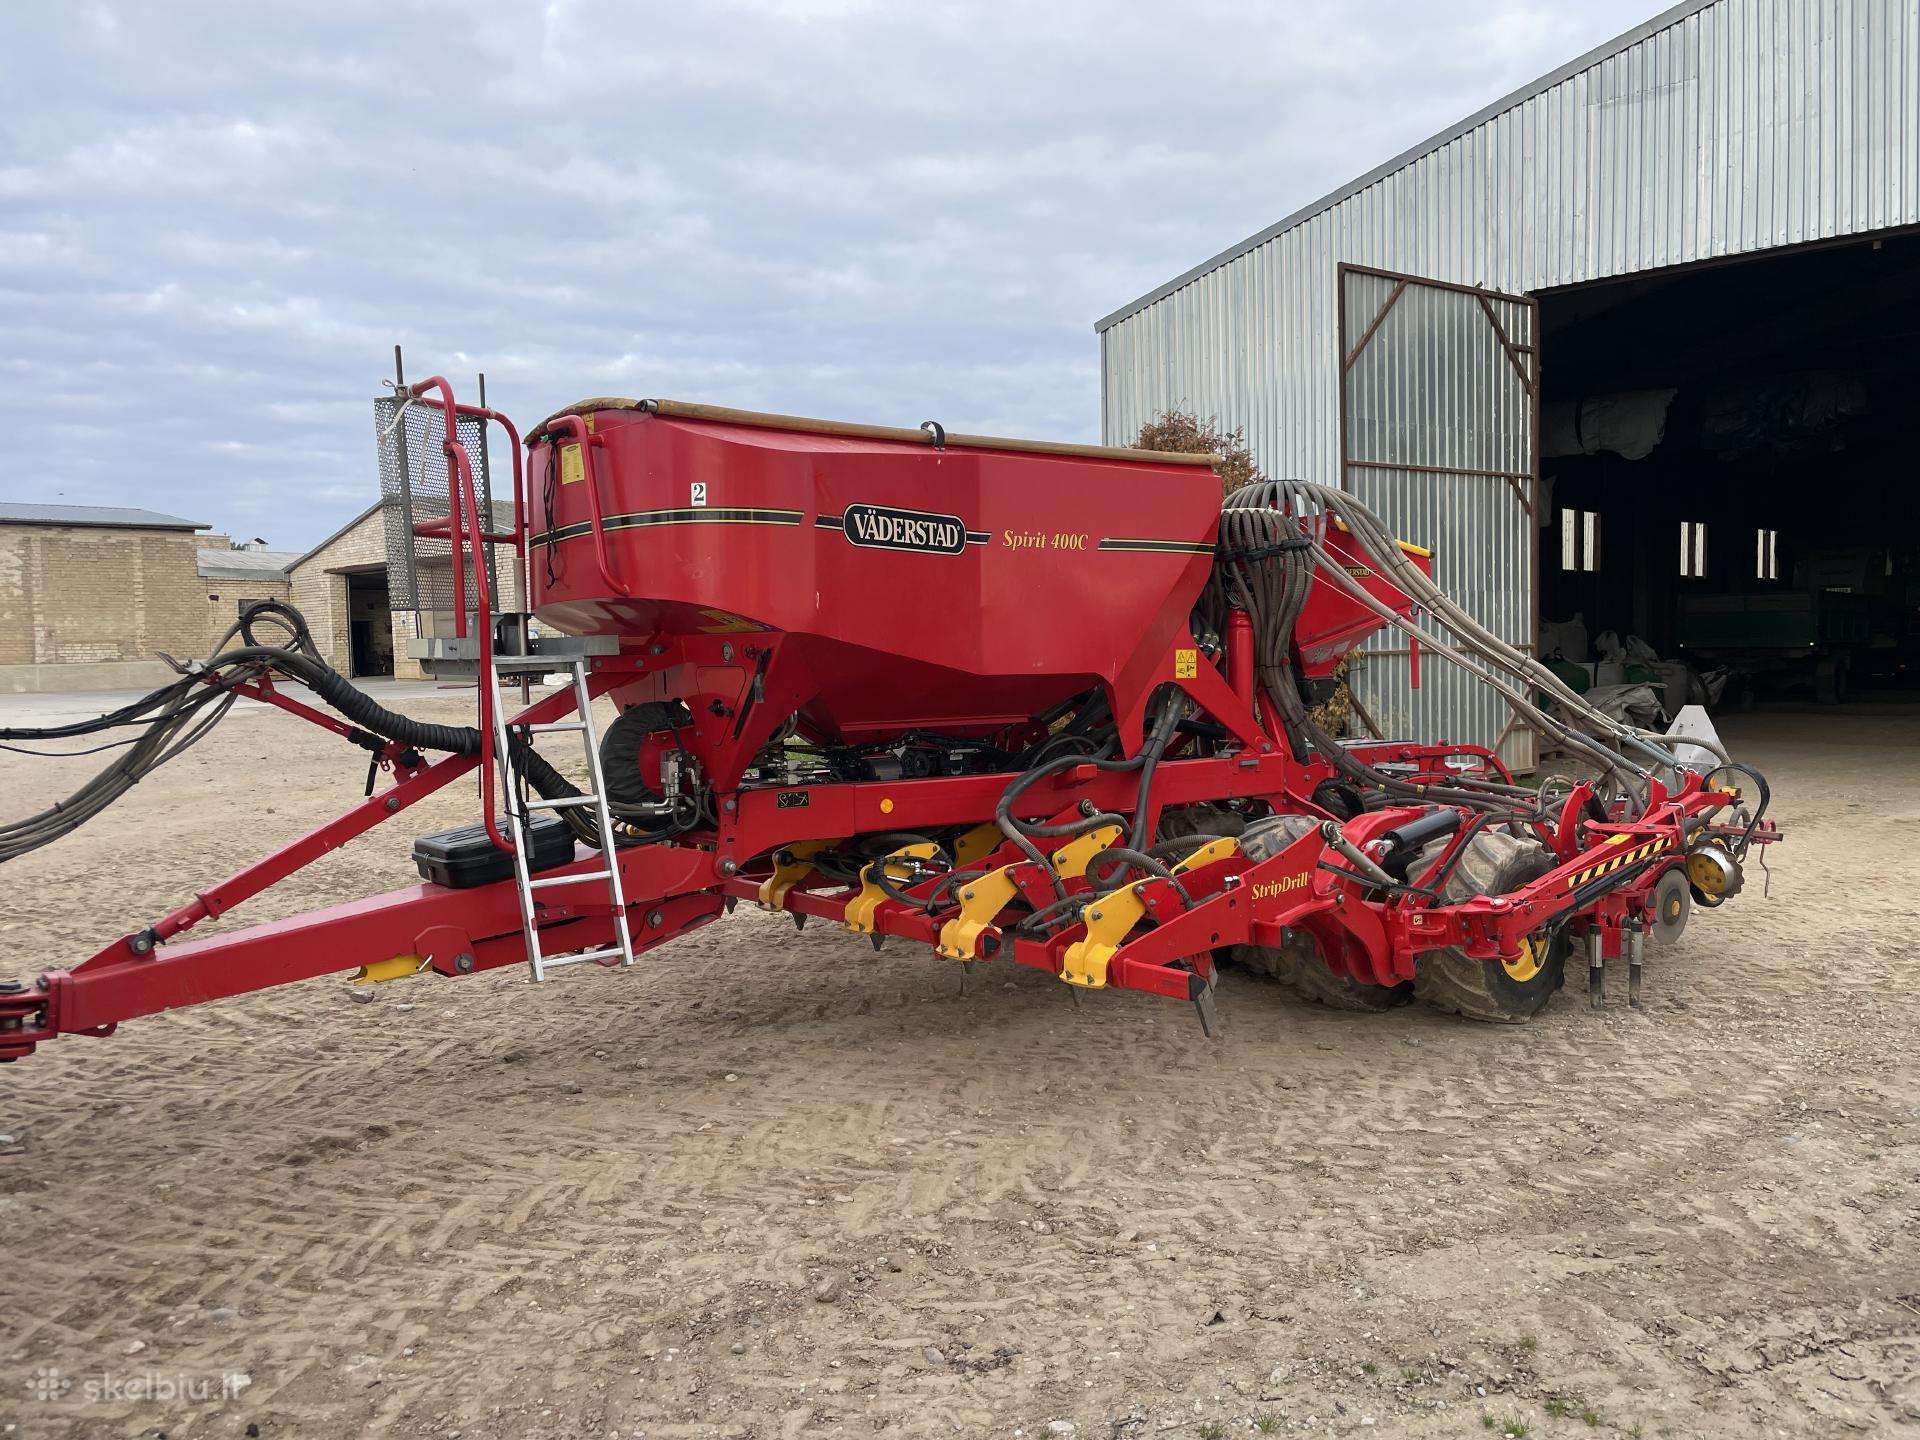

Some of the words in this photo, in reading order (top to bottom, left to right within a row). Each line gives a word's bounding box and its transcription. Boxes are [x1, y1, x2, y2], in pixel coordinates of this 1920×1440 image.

[693, 483, 705, 502] 2
[853, 508, 960, 548] VÄDERSTAD
[1002, 529, 1047, 551] Spirit
[1050, 533, 1089, 551] 400C
[1251, 871, 1309, 900] StripDrill
